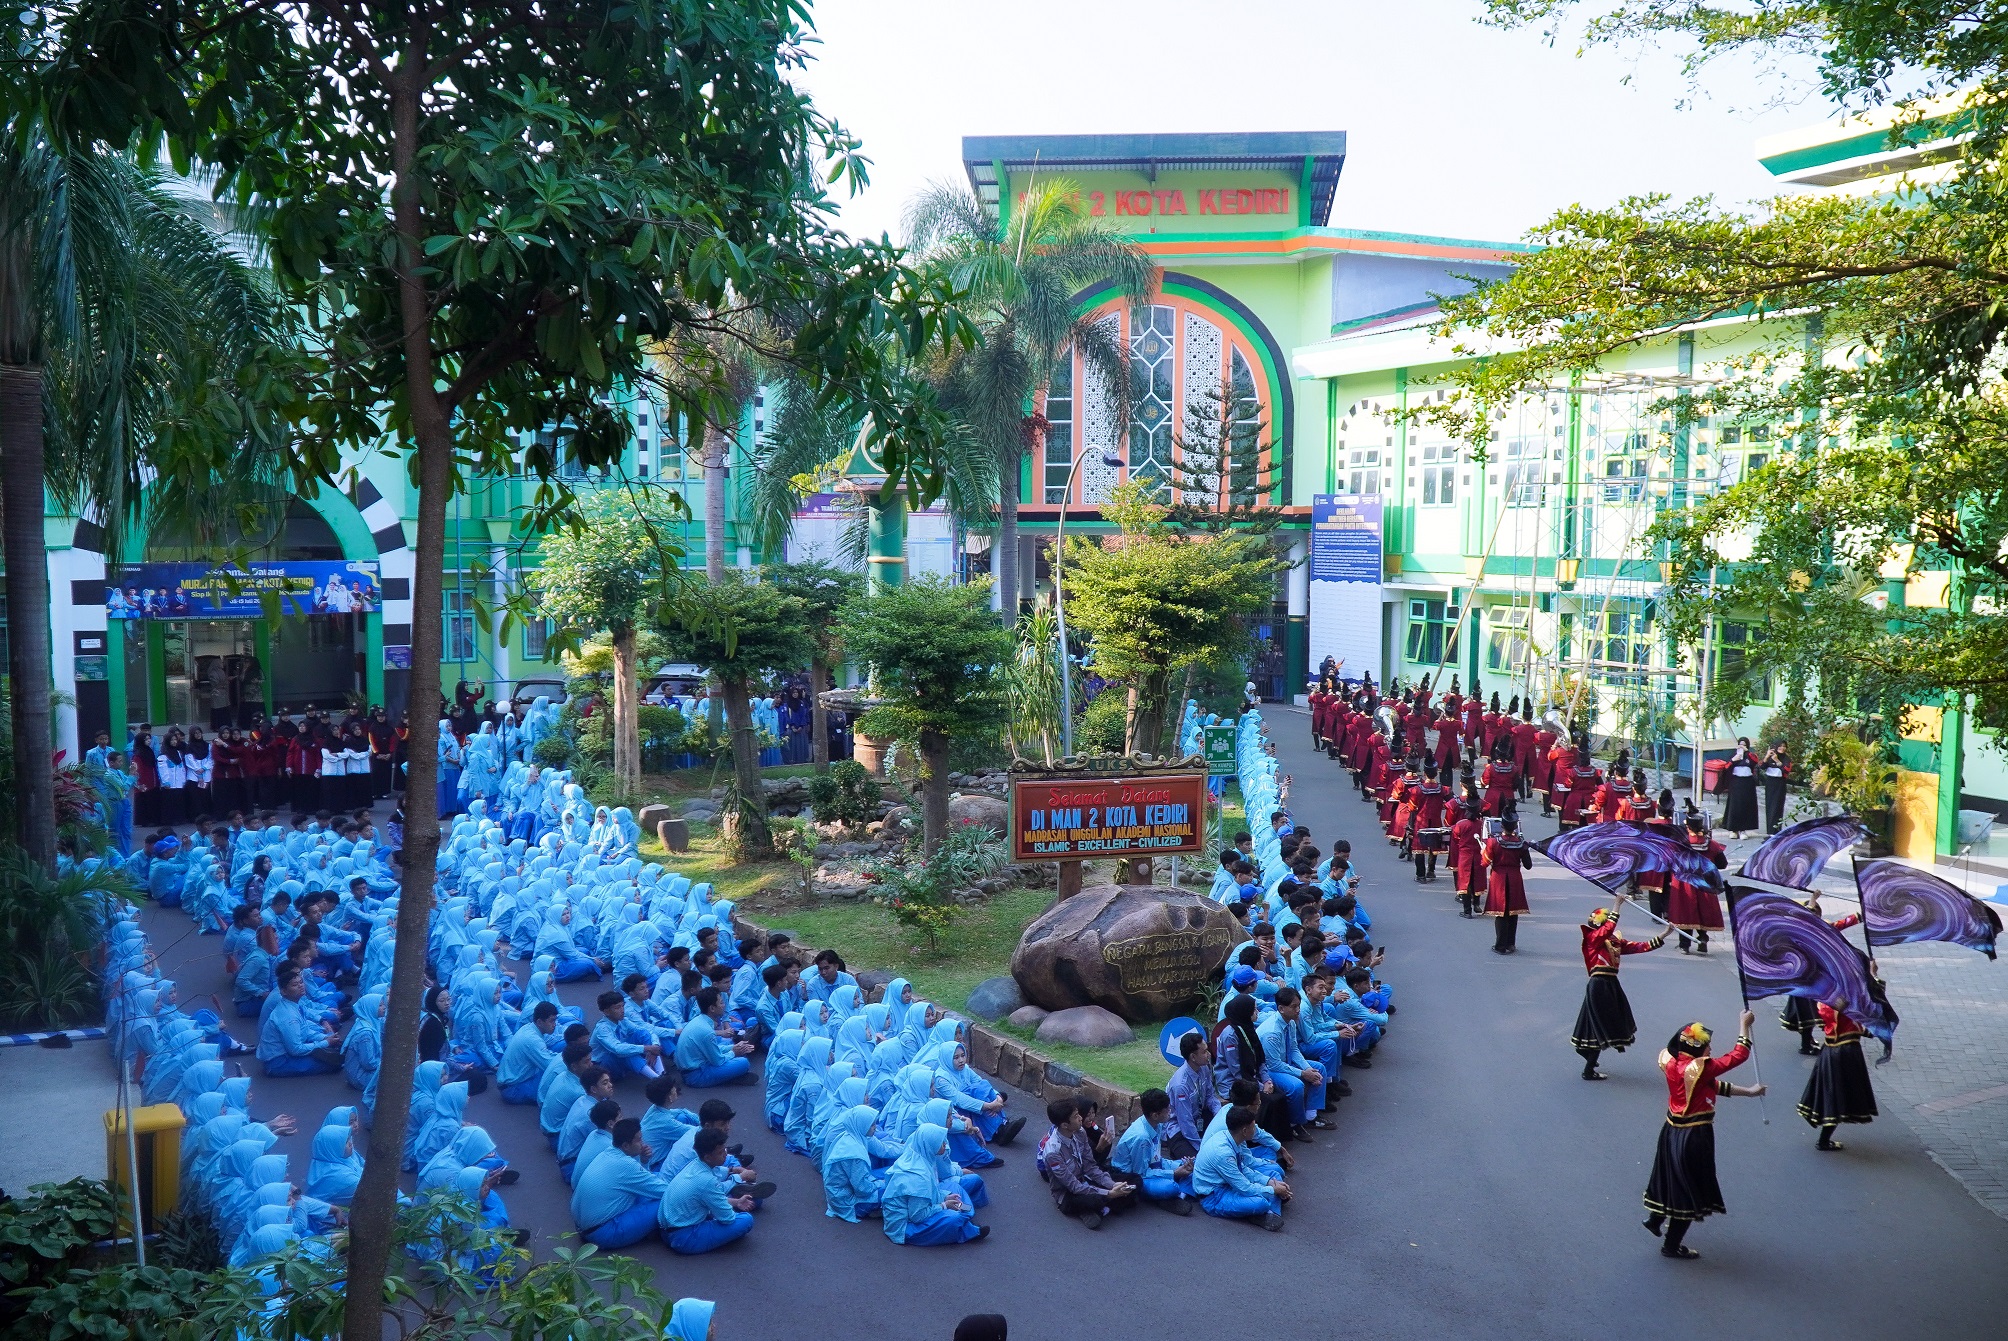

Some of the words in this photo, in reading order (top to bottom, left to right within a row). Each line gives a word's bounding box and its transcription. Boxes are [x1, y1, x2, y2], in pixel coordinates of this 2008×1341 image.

[1090, 191, 1106, 216] 2
[1115, 190, 1189, 216] KOTA
[1199, 188, 1289, 215] KEDIRI
[1095, 758, 1128, 771] UKS
[1048, 787, 1108, 807] Selamat
[1120, 785, 1170, 804] Datang
[1031, 809, 1045, 830] DI
[1051, 808, 1081, 829] MAN
[1088, 807, 1098, 828] 2
[1105, 805, 1137, 827] KOTA
[1145, 803, 1188, 825] KEDIRI
[1024, 829, 1067, 843] MADRASAH
[1070, 828, 1113, 842] UNGGULAN
[1115, 825, 1151, 839] AKADEMI
[1154, 823, 1194, 837] NASIONAL
